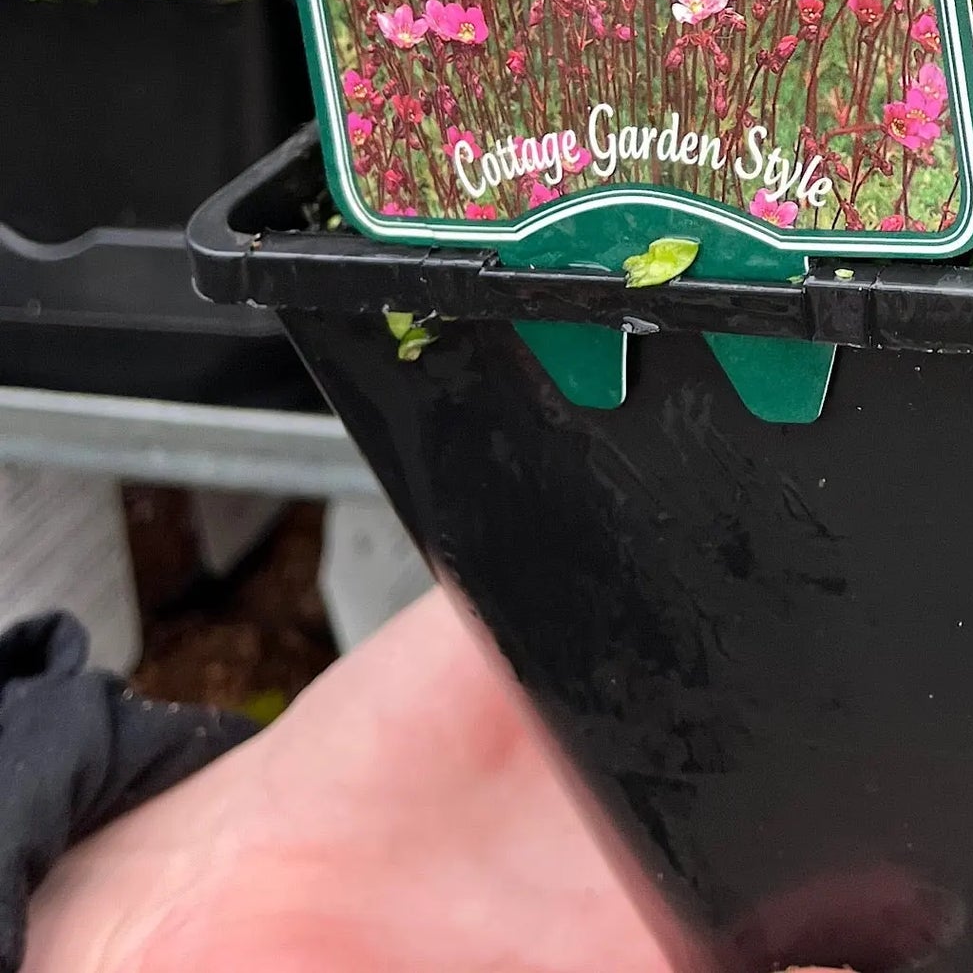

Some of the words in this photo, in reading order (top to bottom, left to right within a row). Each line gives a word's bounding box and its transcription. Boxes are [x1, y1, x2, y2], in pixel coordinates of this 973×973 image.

[453, 129, 582, 199] Cottage
[588, 103, 727, 178] Garden
[734, 125, 833, 207] Style
